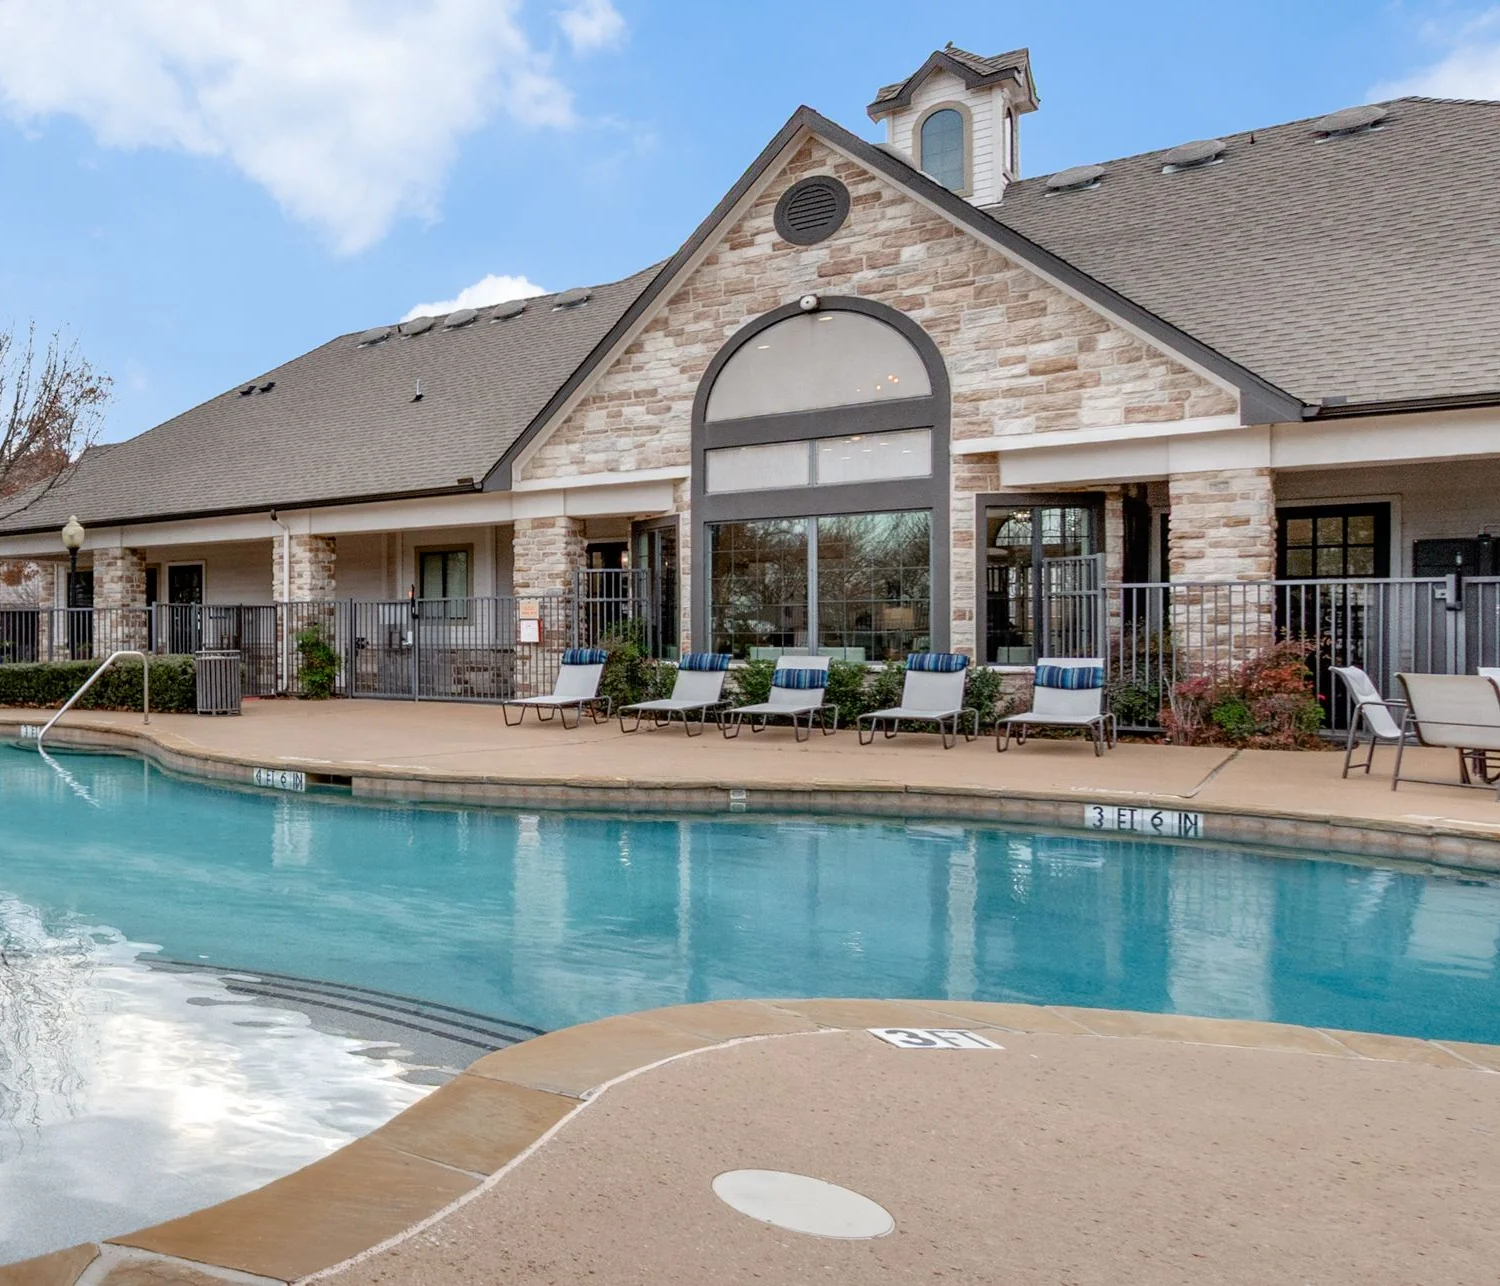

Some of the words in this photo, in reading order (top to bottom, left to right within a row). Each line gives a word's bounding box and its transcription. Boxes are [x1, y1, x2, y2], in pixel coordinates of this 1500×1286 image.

[280, 772, 287, 784] 6
[1151, 811, 1164, 826] 6
[884, 1029, 938, 1047] 3
[924, 1030, 992, 1048] FT
